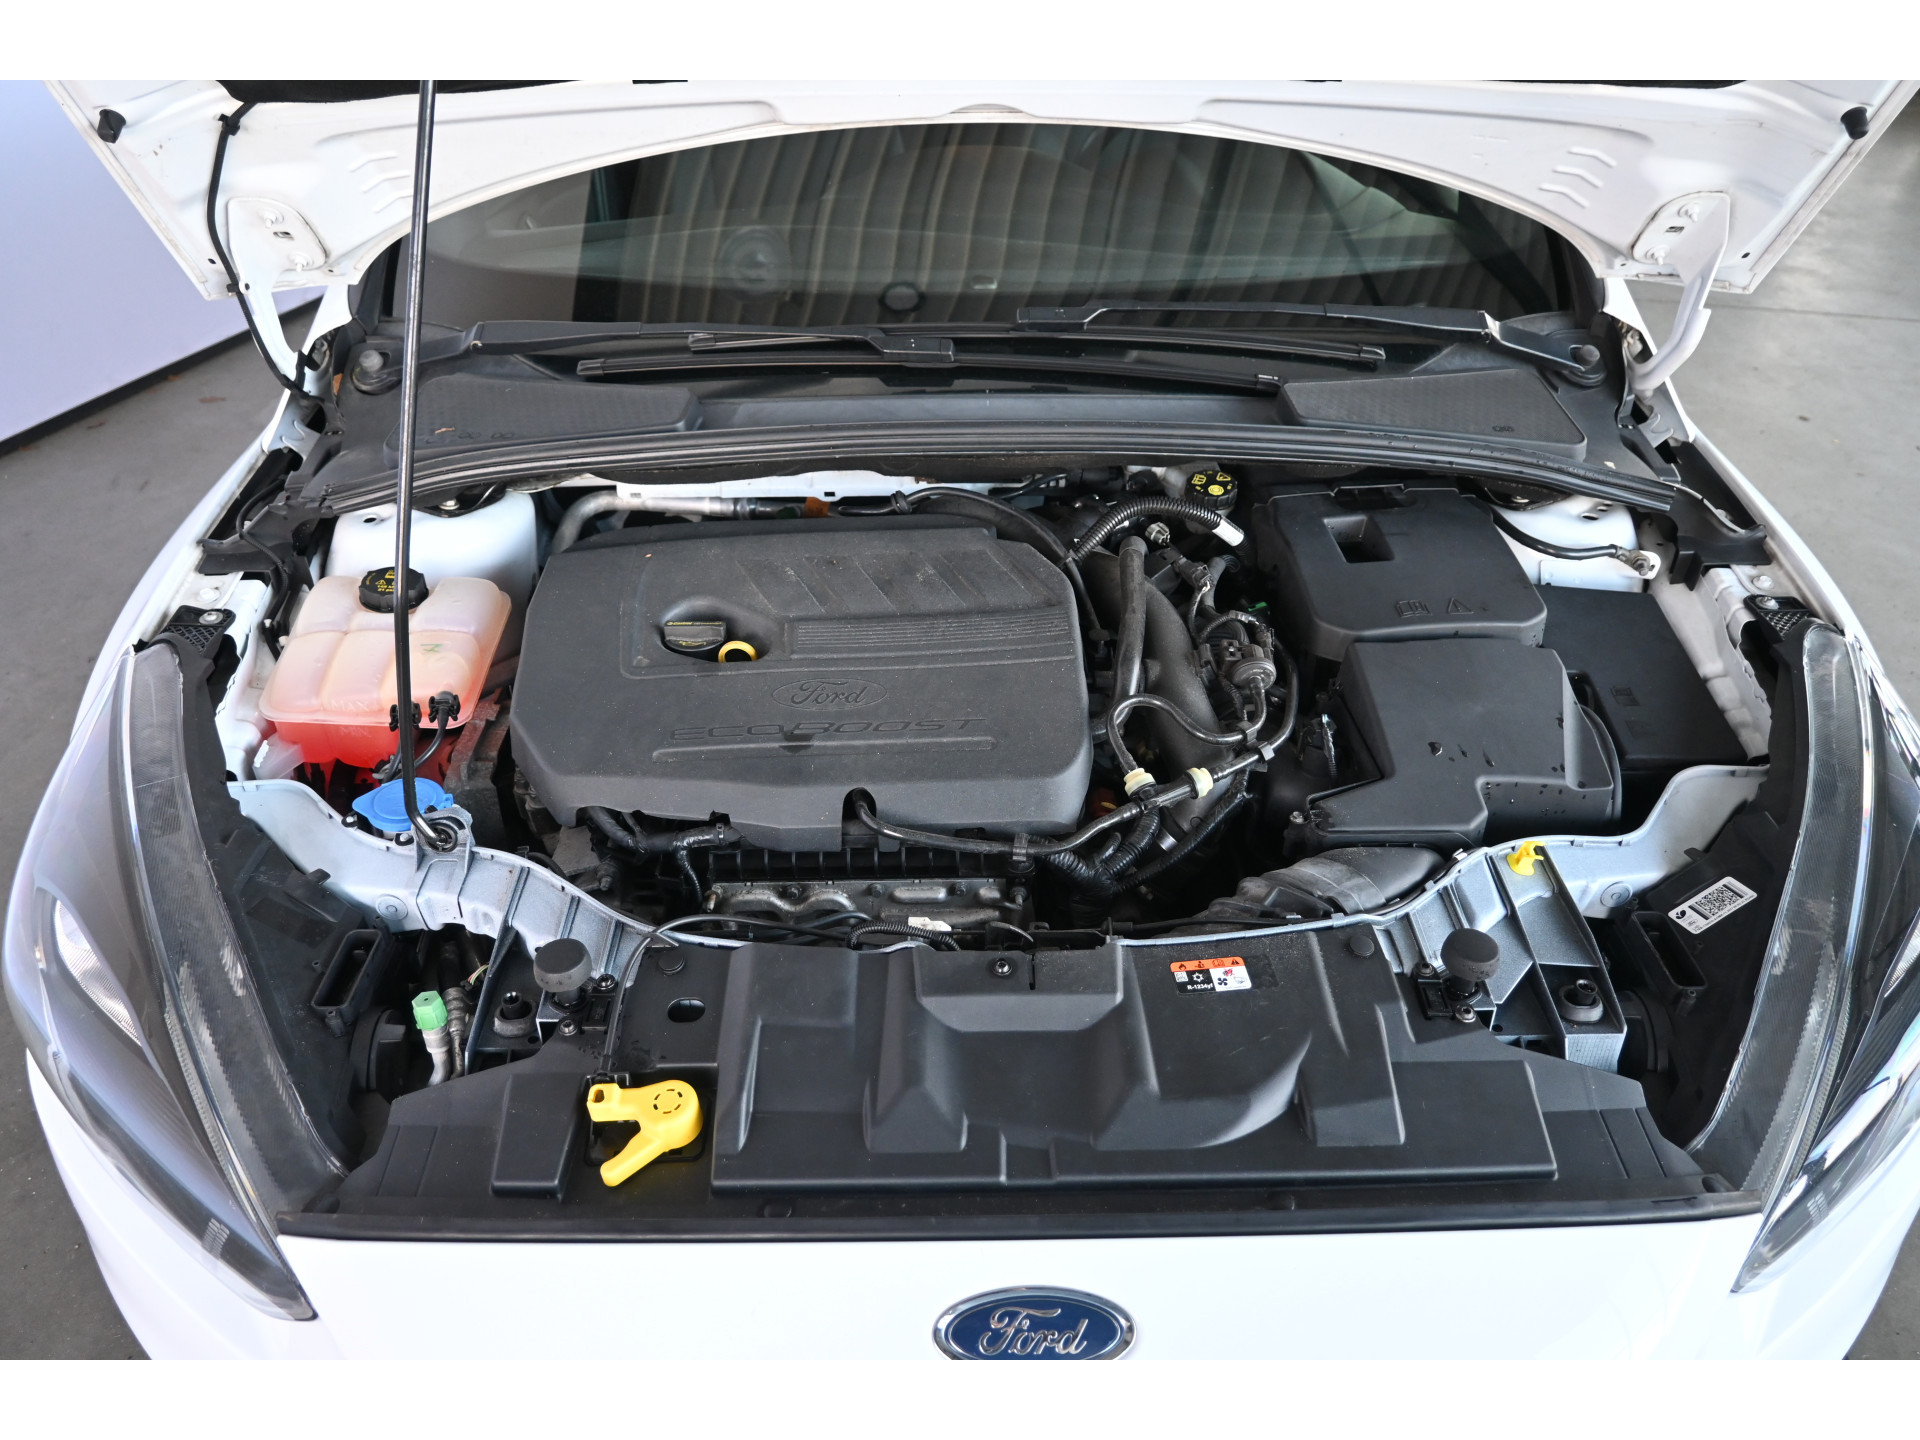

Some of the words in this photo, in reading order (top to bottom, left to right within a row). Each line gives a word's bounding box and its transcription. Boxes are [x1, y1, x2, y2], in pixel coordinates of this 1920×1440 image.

[790, 681, 868, 705] Ford
[331, 699, 369, 712] MAX
[672, 718, 987, 740] ECOBOOST
[978, 1306, 1089, 1356] Ford
